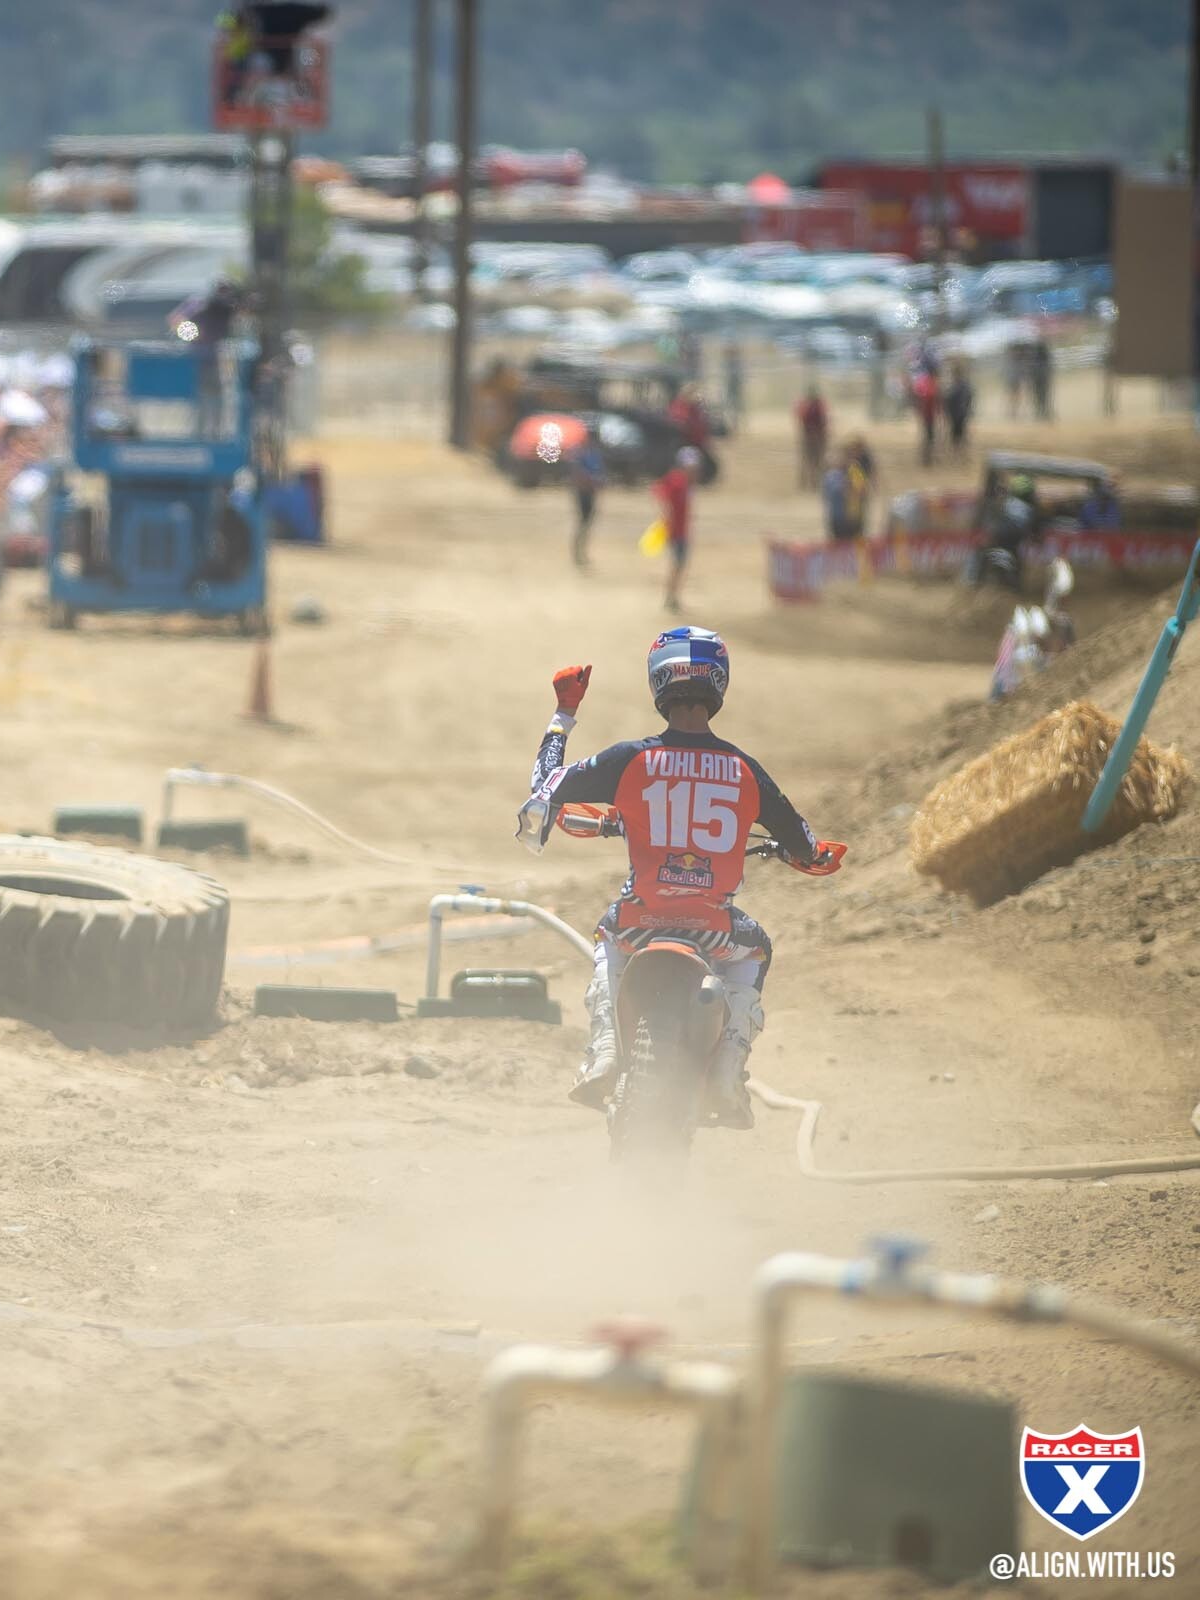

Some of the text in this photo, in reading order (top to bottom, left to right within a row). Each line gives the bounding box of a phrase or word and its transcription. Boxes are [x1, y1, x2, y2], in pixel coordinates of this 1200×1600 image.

[645, 750, 742, 783] VOHLAND
[642, 780, 741, 854] 115
[659, 868, 713, 887] Red Bull
